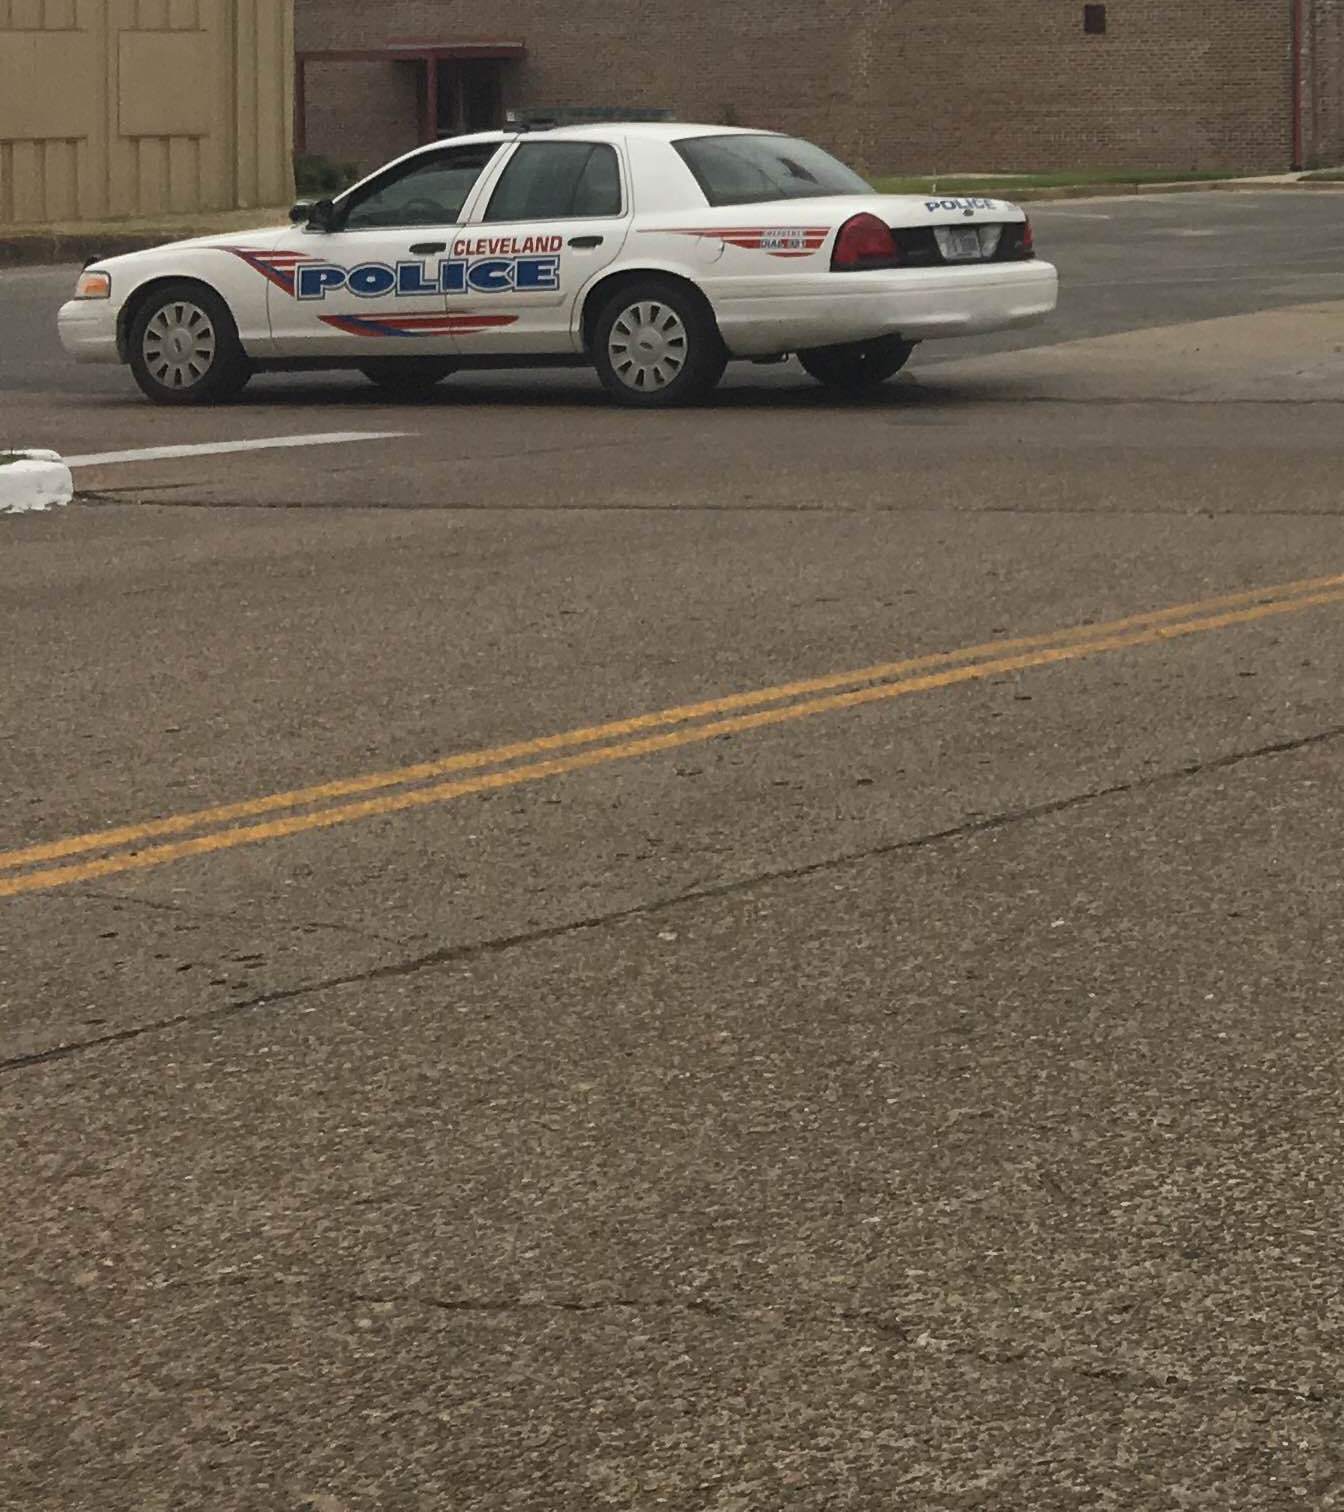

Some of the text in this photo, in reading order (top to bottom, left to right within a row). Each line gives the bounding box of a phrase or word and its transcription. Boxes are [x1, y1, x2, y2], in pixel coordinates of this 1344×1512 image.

[925, 197, 997, 212] POLICE
[453, 235, 563, 256] CLEVELAND
[297, 254, 560, 300] POLICE
